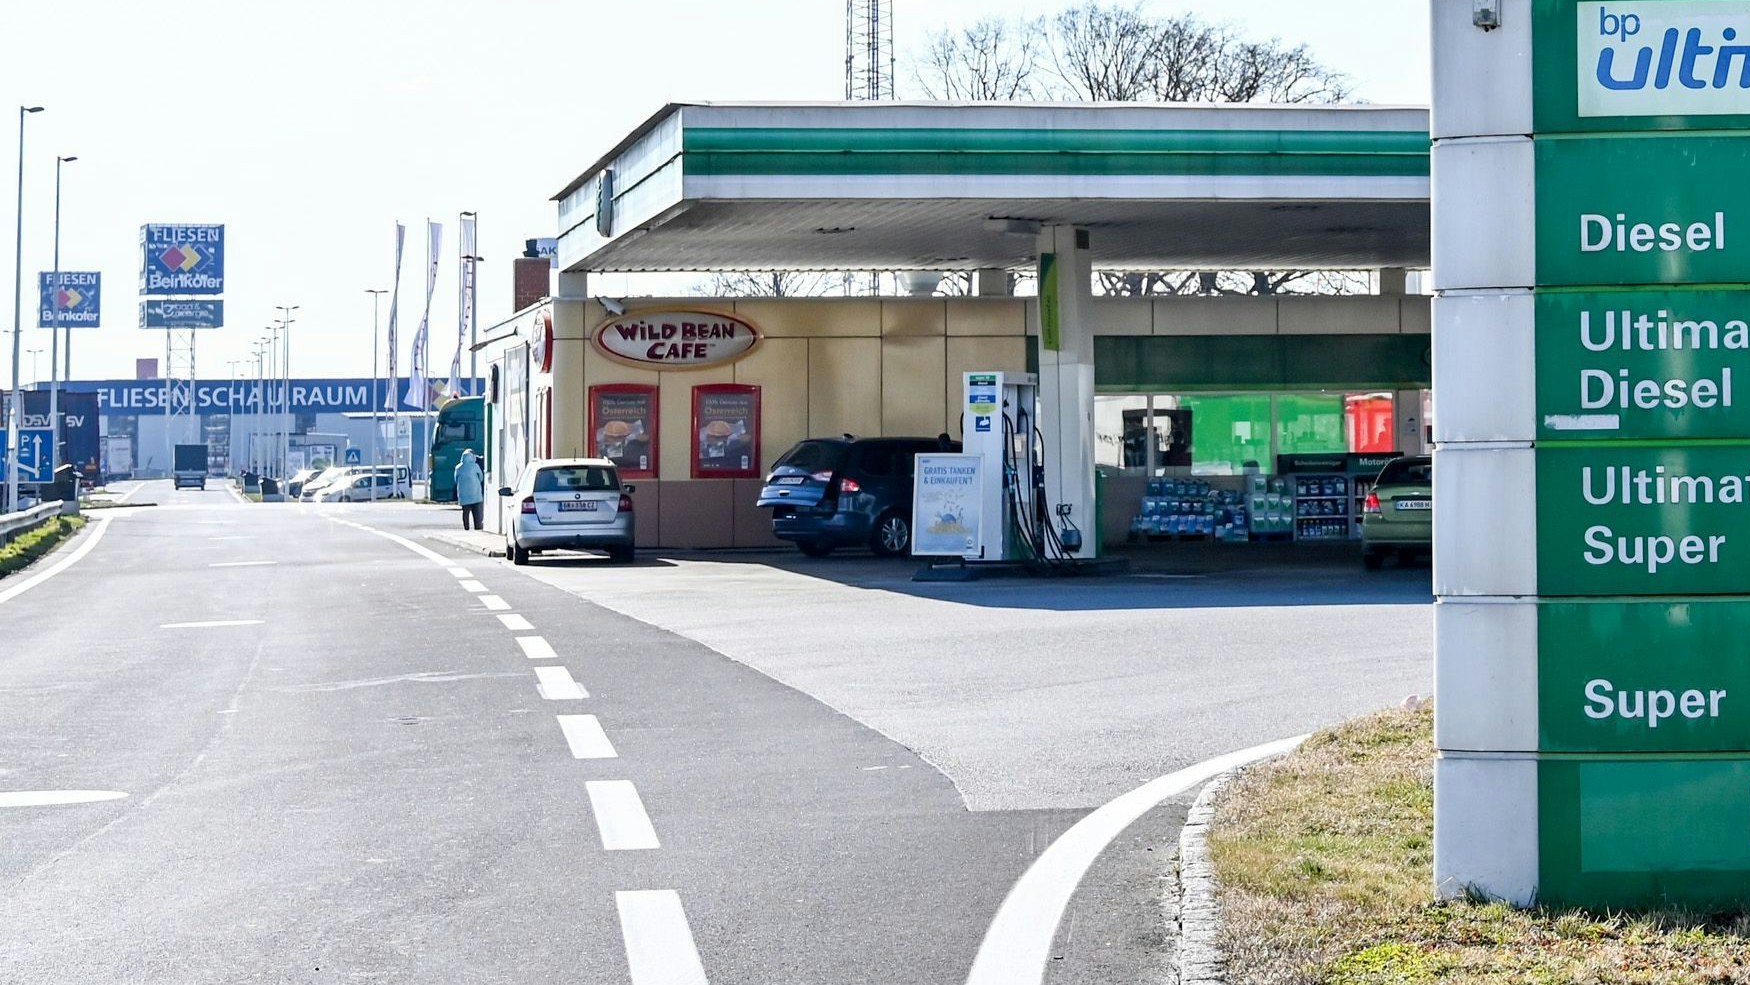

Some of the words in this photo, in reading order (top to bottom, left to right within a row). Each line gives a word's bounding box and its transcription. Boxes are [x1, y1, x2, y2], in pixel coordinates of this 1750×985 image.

[1600, 6, 1640, 42] bp
[153, 228, 219, 242] FLIESEN
[1580, 212, 1725, 252] Diesel
[682, 323, 735, 340] BEAN
[646, 342, 707, 360] CAFE
[1580, 367, 1731, 409] Diesel
[22, 436, 29, 447] P
[924, 466, 947, 475] GRATIS
[948, 466, 975, 475] TANKEN
[1584, 525, 1726, 573] Super
[1584, 678, 1727, 728] Super
